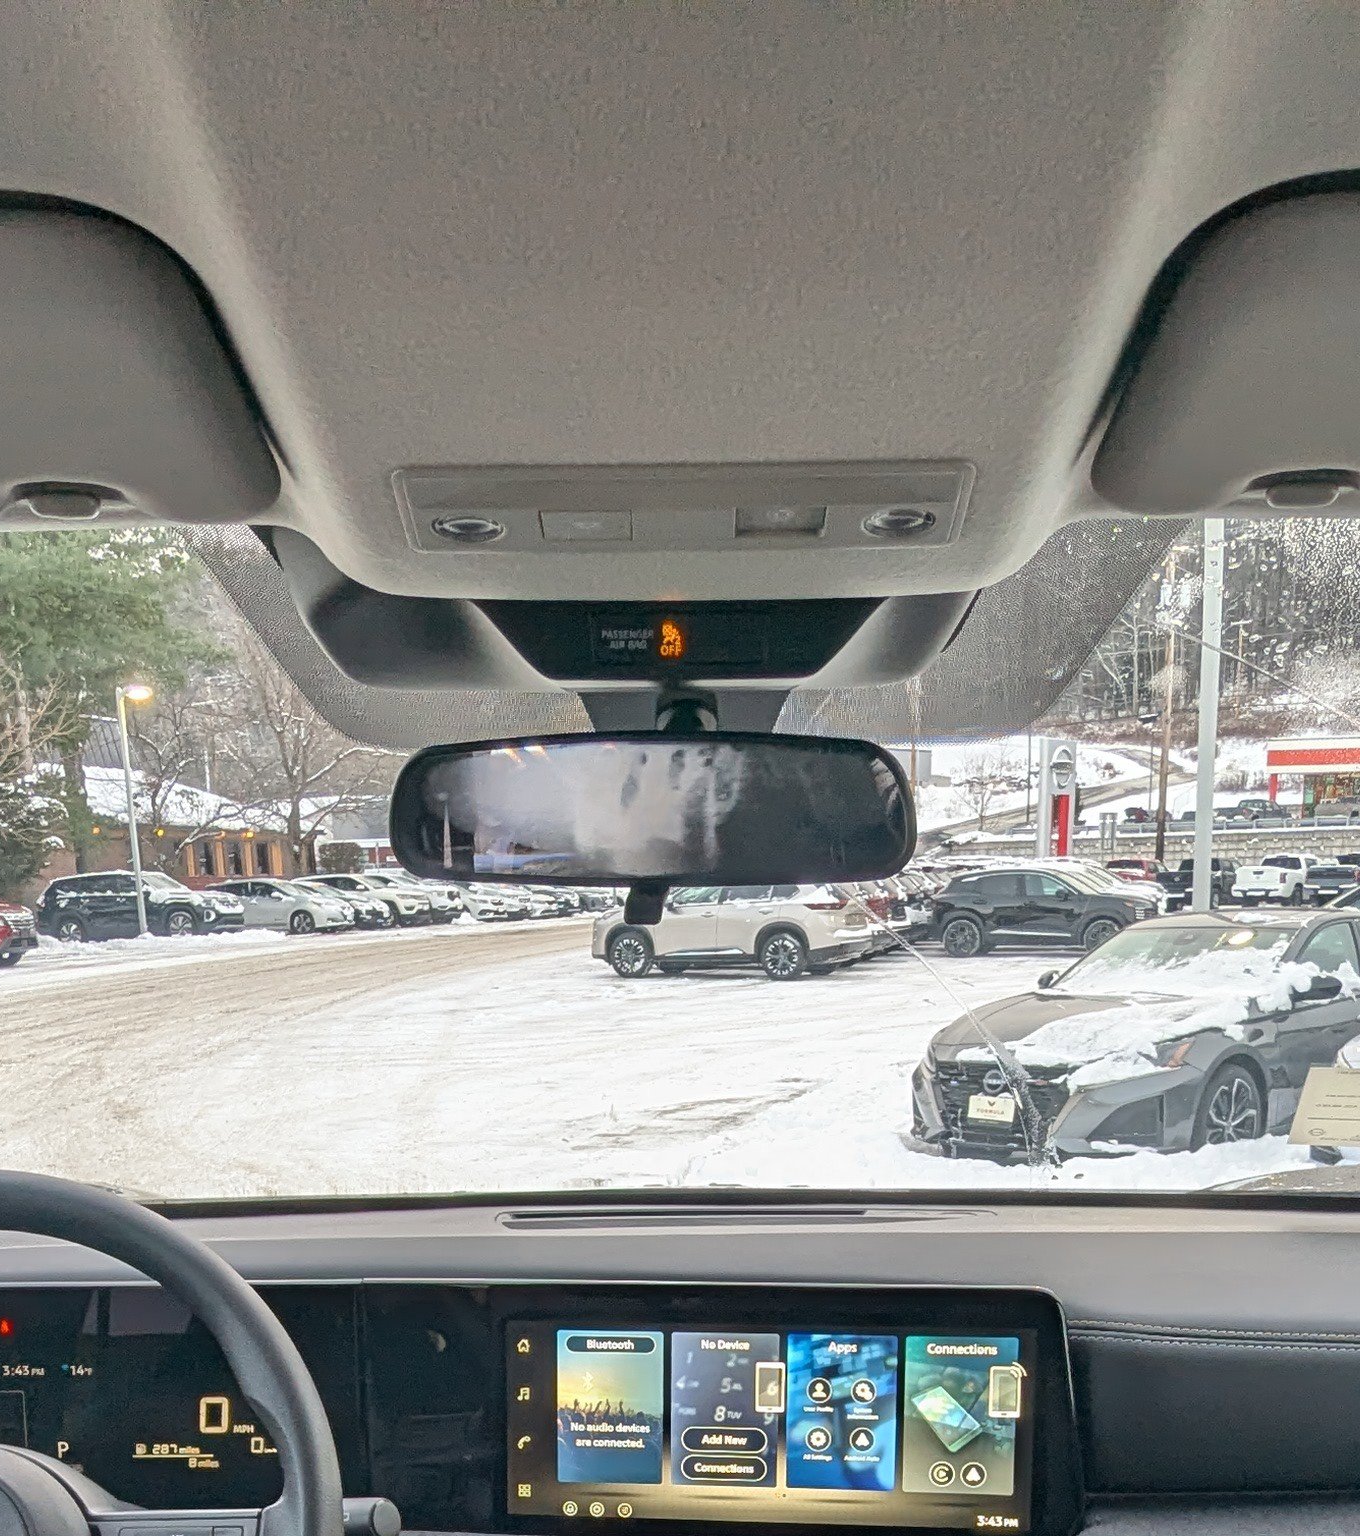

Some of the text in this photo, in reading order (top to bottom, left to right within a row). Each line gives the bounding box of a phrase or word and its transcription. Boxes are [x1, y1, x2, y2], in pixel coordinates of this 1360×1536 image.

[601, 629, 654, 639] PASSENGER
[660, 644, 682, 656] OFF
[586, 1339, 635, 1350] Bluetooth
[700, 1339, 751, 1351] No Device
[828, 1341, 858, 1354] Apps
[927, 1343, 999, 1355] Connections
[2, 1365, 30, 1376] 3:43
[199, 1396, 230, 1434] 0
[233, 1424, 255, 1434] MPH
[570, 1422, 651, 1434] No audio devices
[575, 1438, 646, 1449] are connected.
[701, 1434, 748, 1446] Add New
[57, 1440, 70, 1459] P
[151, 1443, 178, 1455] 287
[188, 1458, 197, 1469] 8
[693, 1462, 755, 1475] Connections
[976, 1515, 1019, 1528] 3:43 PM
